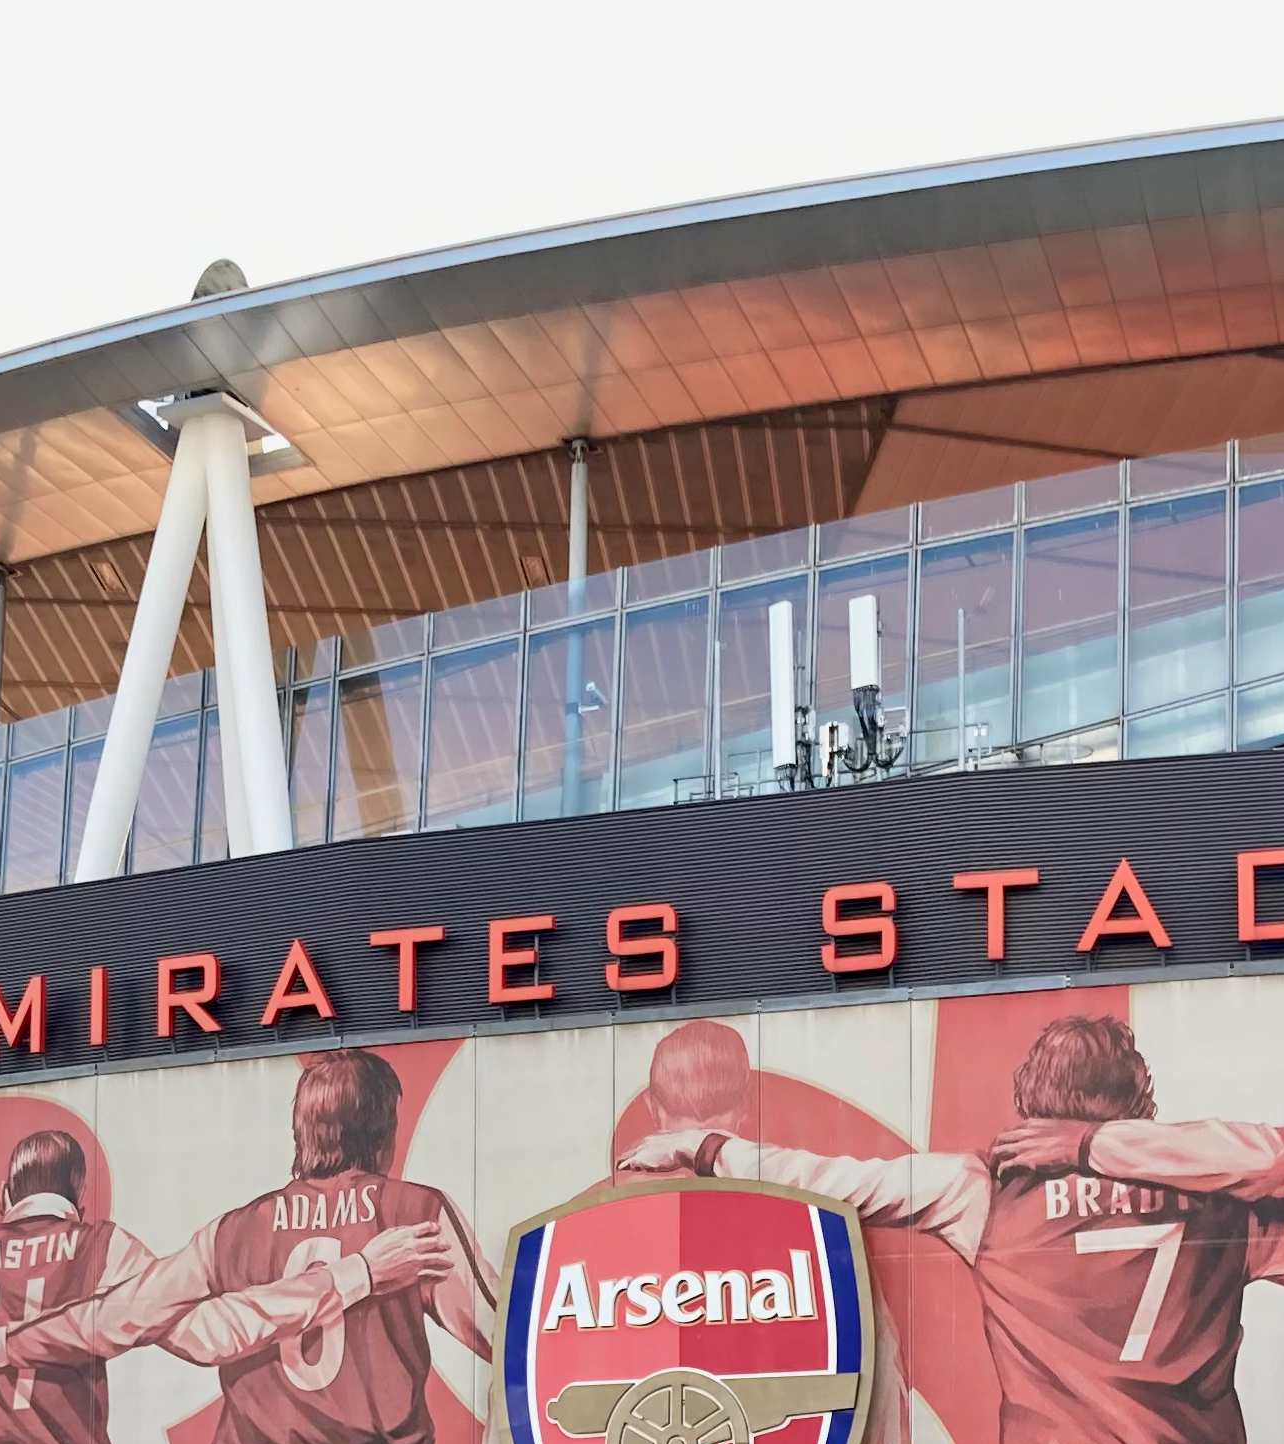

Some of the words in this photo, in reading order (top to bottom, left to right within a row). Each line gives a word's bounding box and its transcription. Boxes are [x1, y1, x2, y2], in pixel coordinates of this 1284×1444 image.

[273, 1184, 378, 1232] ADAMS
[543, 1248, 819, 1334] Arsenal
[1075, 1221, 1187, 1362] 7
